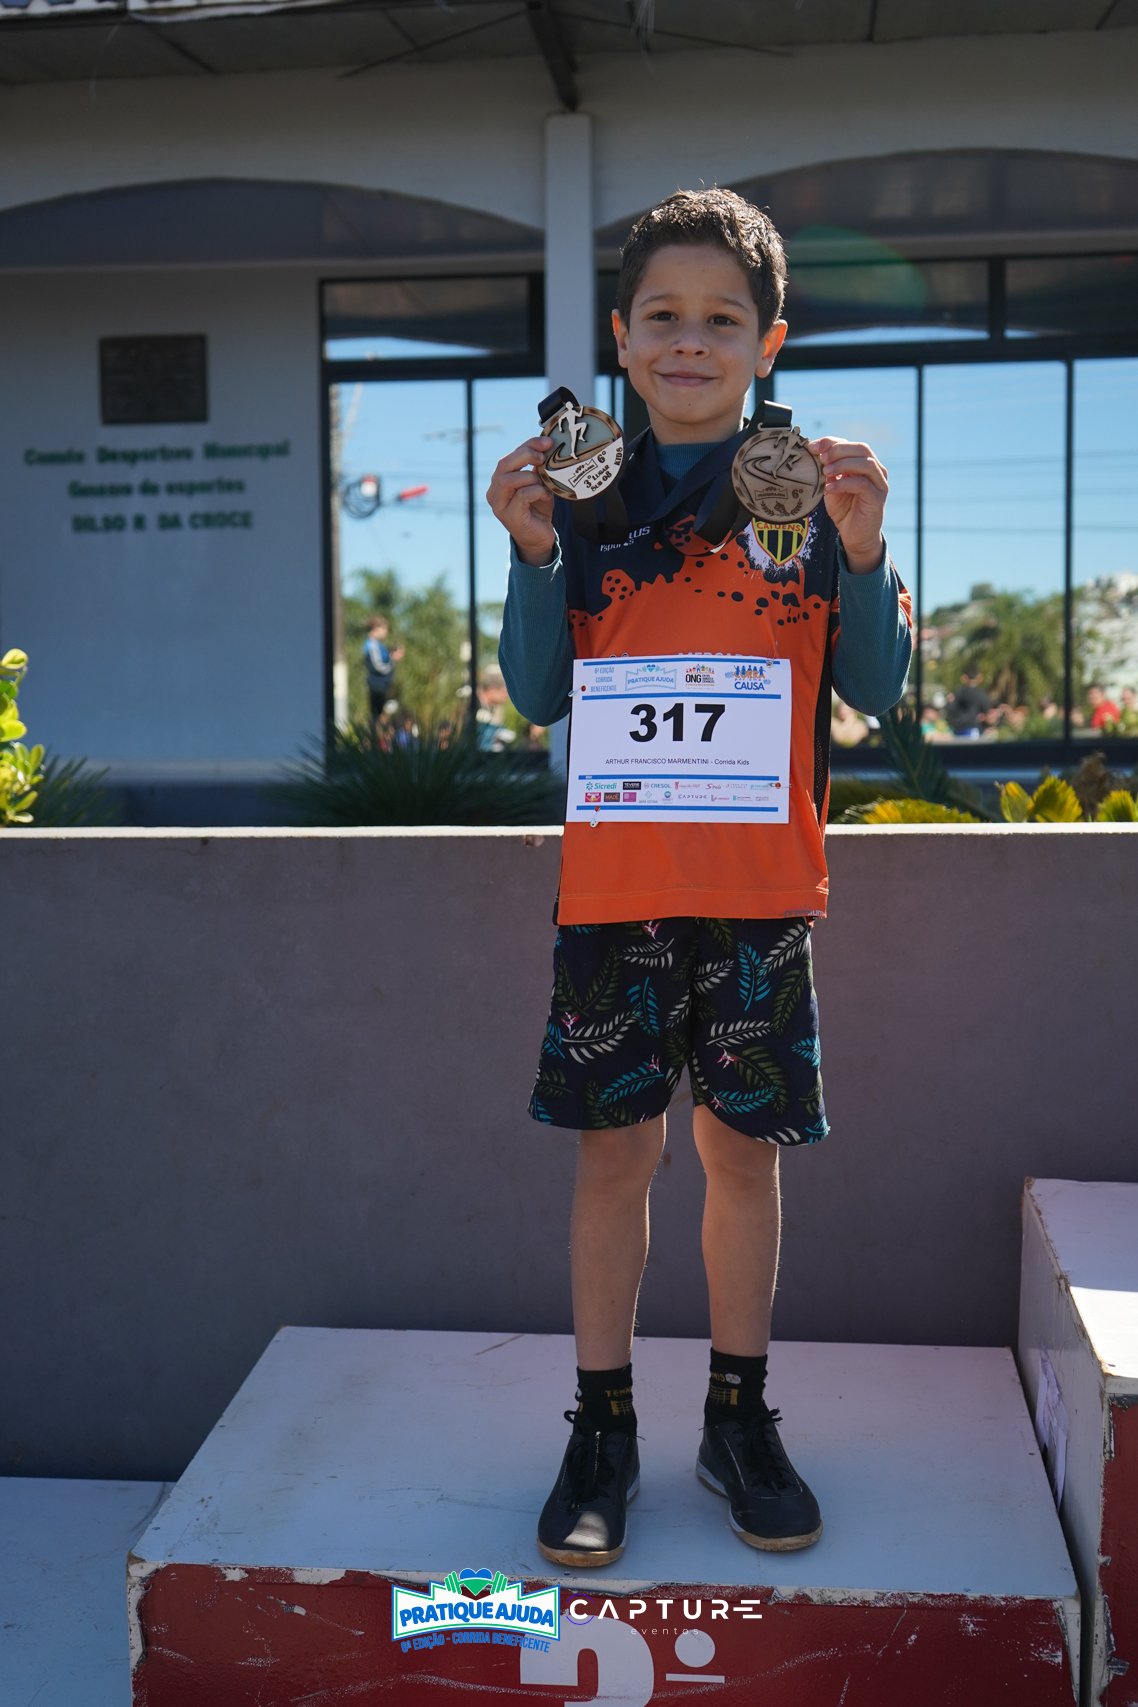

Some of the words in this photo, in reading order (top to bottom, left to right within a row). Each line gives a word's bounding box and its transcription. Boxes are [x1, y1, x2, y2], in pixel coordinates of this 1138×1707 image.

[613, 446, 623, 466] KIDS
[627, 676, 656, 685] PRATIQUE
[655, 676, 674, 684] AJUDA
[685, 673, 702, 683] ONG
[590, 685, 617, 693] BENEFICENTE
[734, 681, 765, 690] CAUSA
[629, 702, 725, 743] 317
[594, 782, 617, 790] Sicredi
